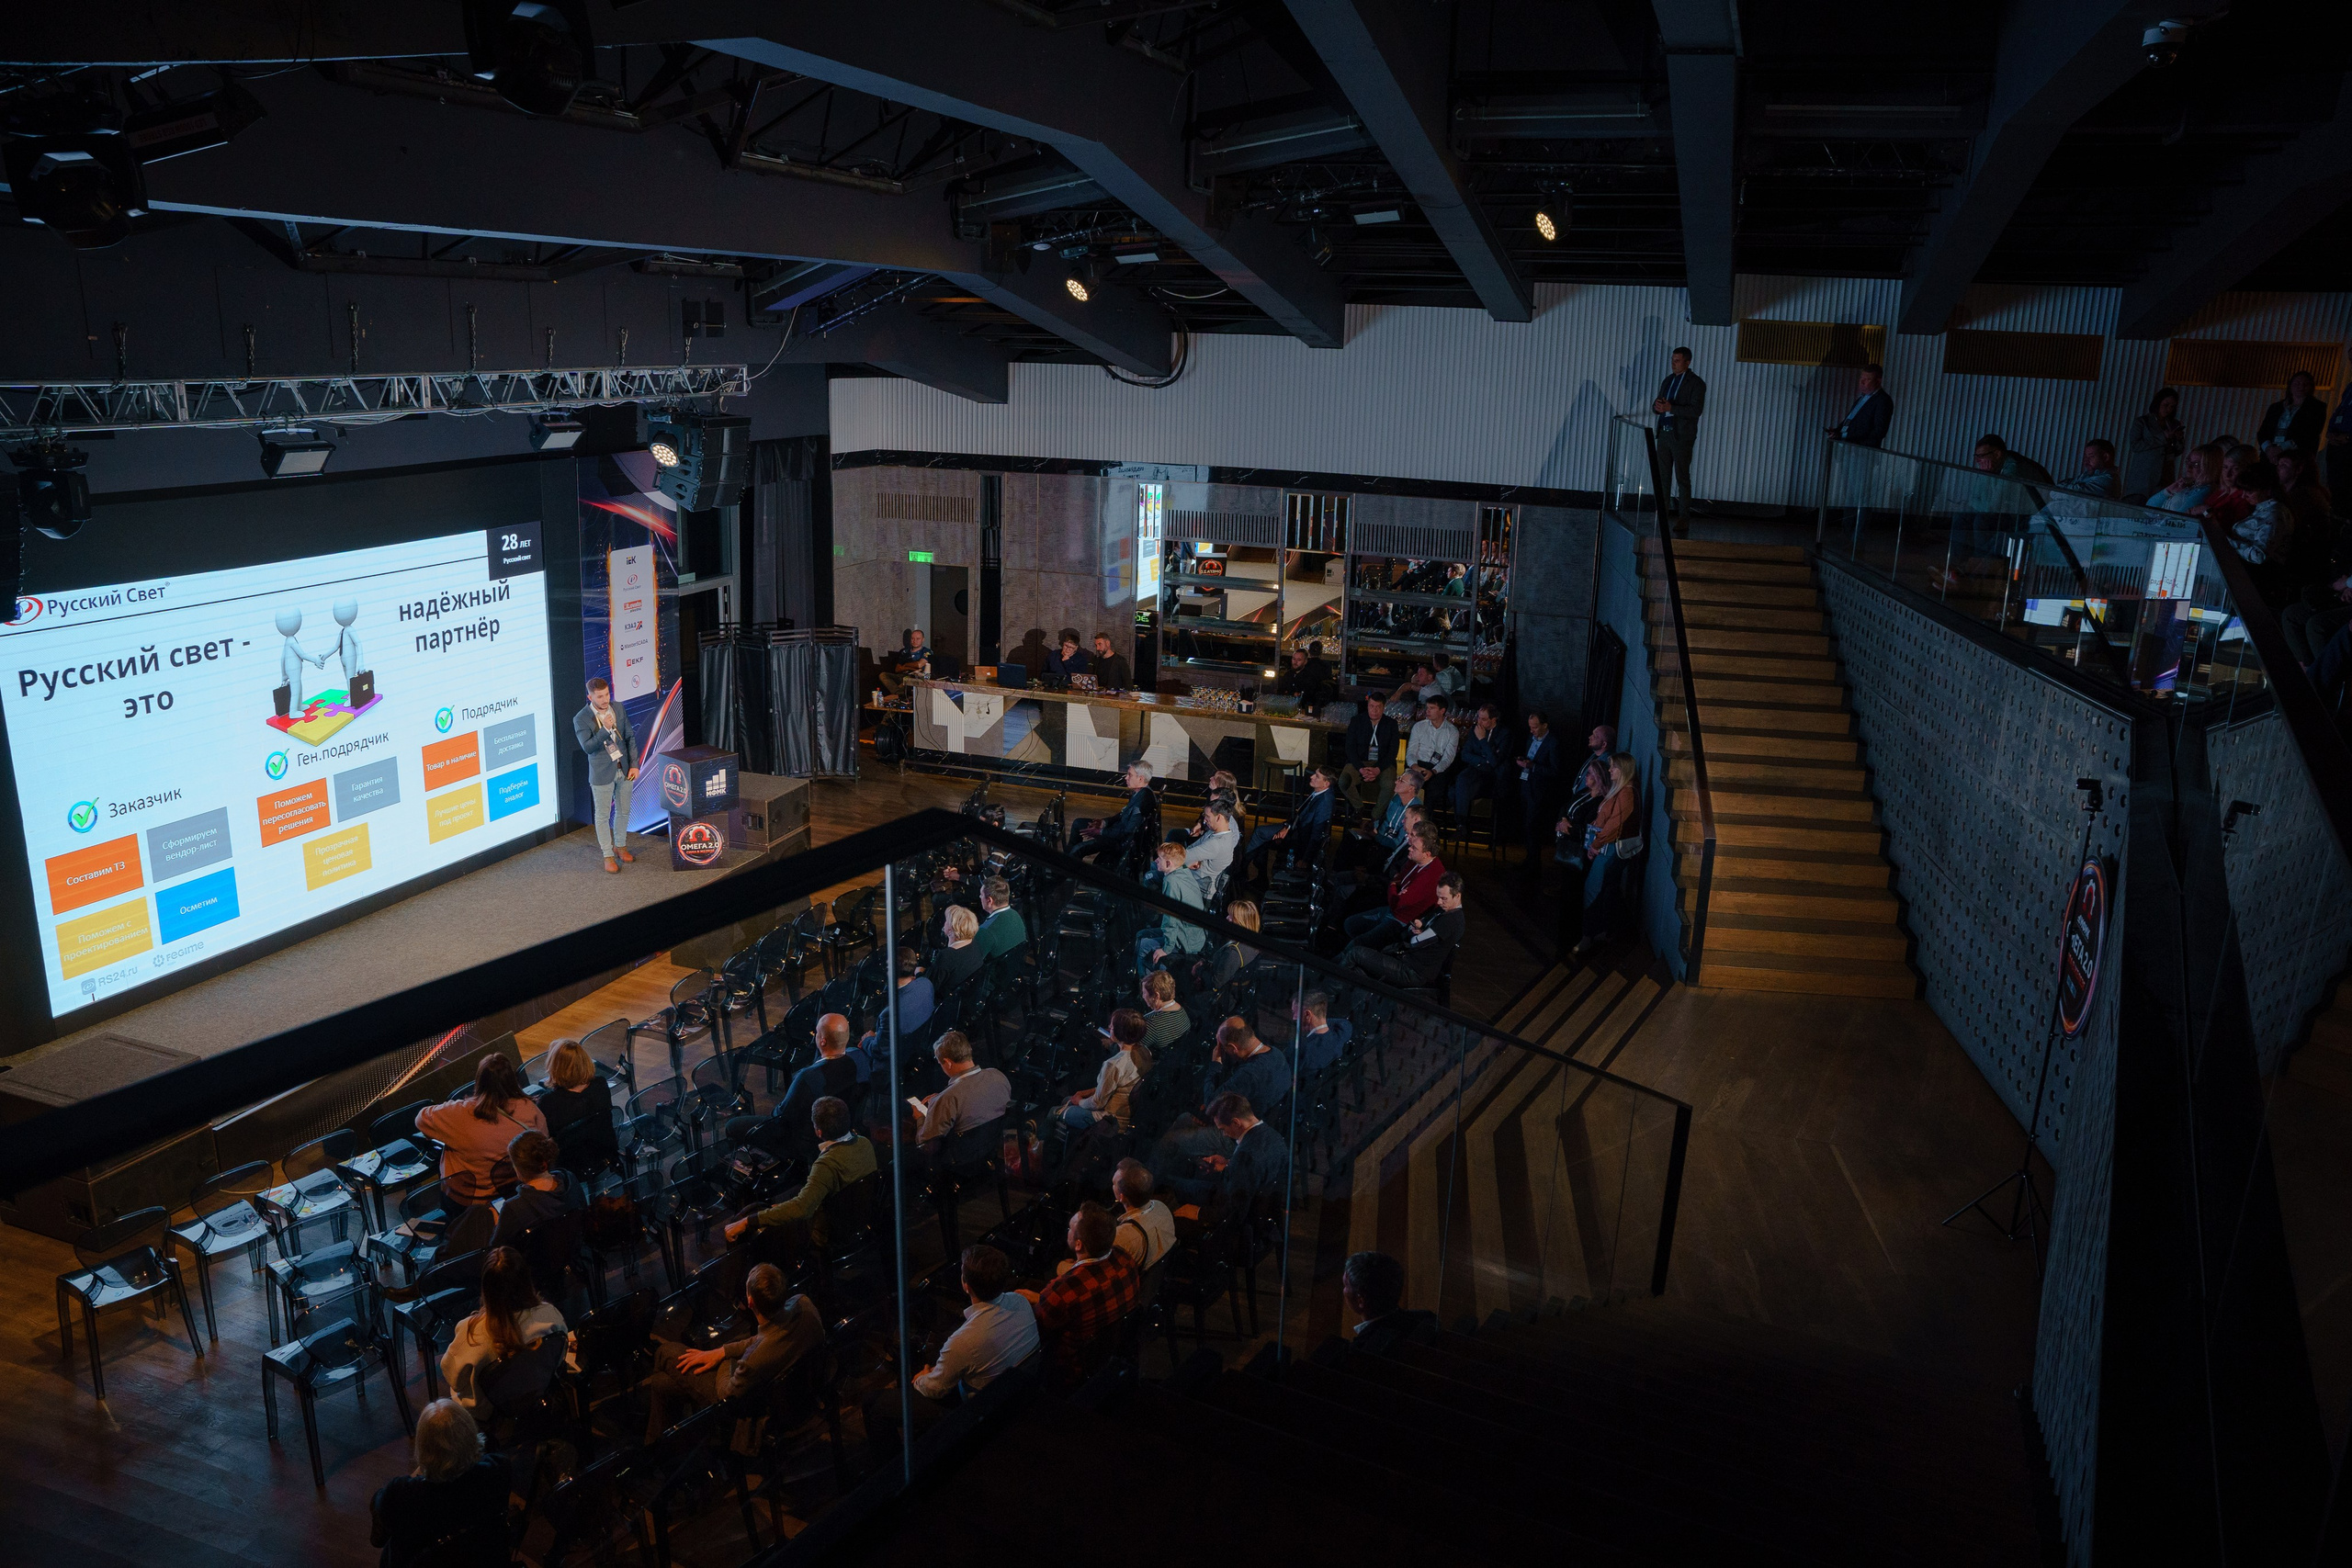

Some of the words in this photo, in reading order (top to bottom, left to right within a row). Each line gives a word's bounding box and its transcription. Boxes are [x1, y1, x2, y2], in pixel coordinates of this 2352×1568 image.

[502, 534, 519, 551] 28
[519, 539, 532, 548] ЛЕТ
[503, 555, 522, 565] Русский
[47, 590, 121, 617] Русский
[126, 587, 166, 603] Свет
[399, 579, 511, 622] надёжный
[415, 616, 500, 653] партнёр
[18, 645, 160, 701] Русский
[169, 637, 234, 668] свет
[631, 656, 644, 665] EKF
[123, 690, 174, 718] это
[461, 696, 518, 720] Подрядчик
[493, 728, 526, 745] Бесплатная
[297, 732, 390, 767] Ген.подрядчик
[498, 741, 525, 755] доставка
[426, 761, 445, 772] Товар
[450, 750, 477, 763] наличие
[351, 775, 383, 792] Гарантия
[499, 779, 528, 795] Подберём
[664, 781, 680, 792] ОМЕГА
[706, 787, 727, 797] МФМК
[107, 787, 183, 818] Заказчик
[274, 792, 313, 809] Поможем
[353, 788, 384, 803] качества
[504, 791, 525, 804] аналог
[262, 800, 327, 826] пересогласовать
[435, 804, 459, 818] Лучшие
[459, 797, 476, 809] цены
[278, 815, 314, 834] решения
[439, 818, 452, 827] под
[452, 809, 474, 822] проект
[162, 828, 218, 850] Сформируем
[314, 835, 358, 856] Прозрачная
[681, 842, 707, 851] ОМЕГА
[165, 839, 218, 862] вендор-лист
[323, 849, 354, 865] ценовая
[66, 866, 113, 886] Составим
[113, 861, 126, 872] ТЗ
[322, 860, 356, 877] политика
[179, 897, 218, 915] Осметим
[77, 922, 125, 944] Поможем
[63, 926, 149, 963] проектированием
[97, 966, 139, 987] RS24.ru
